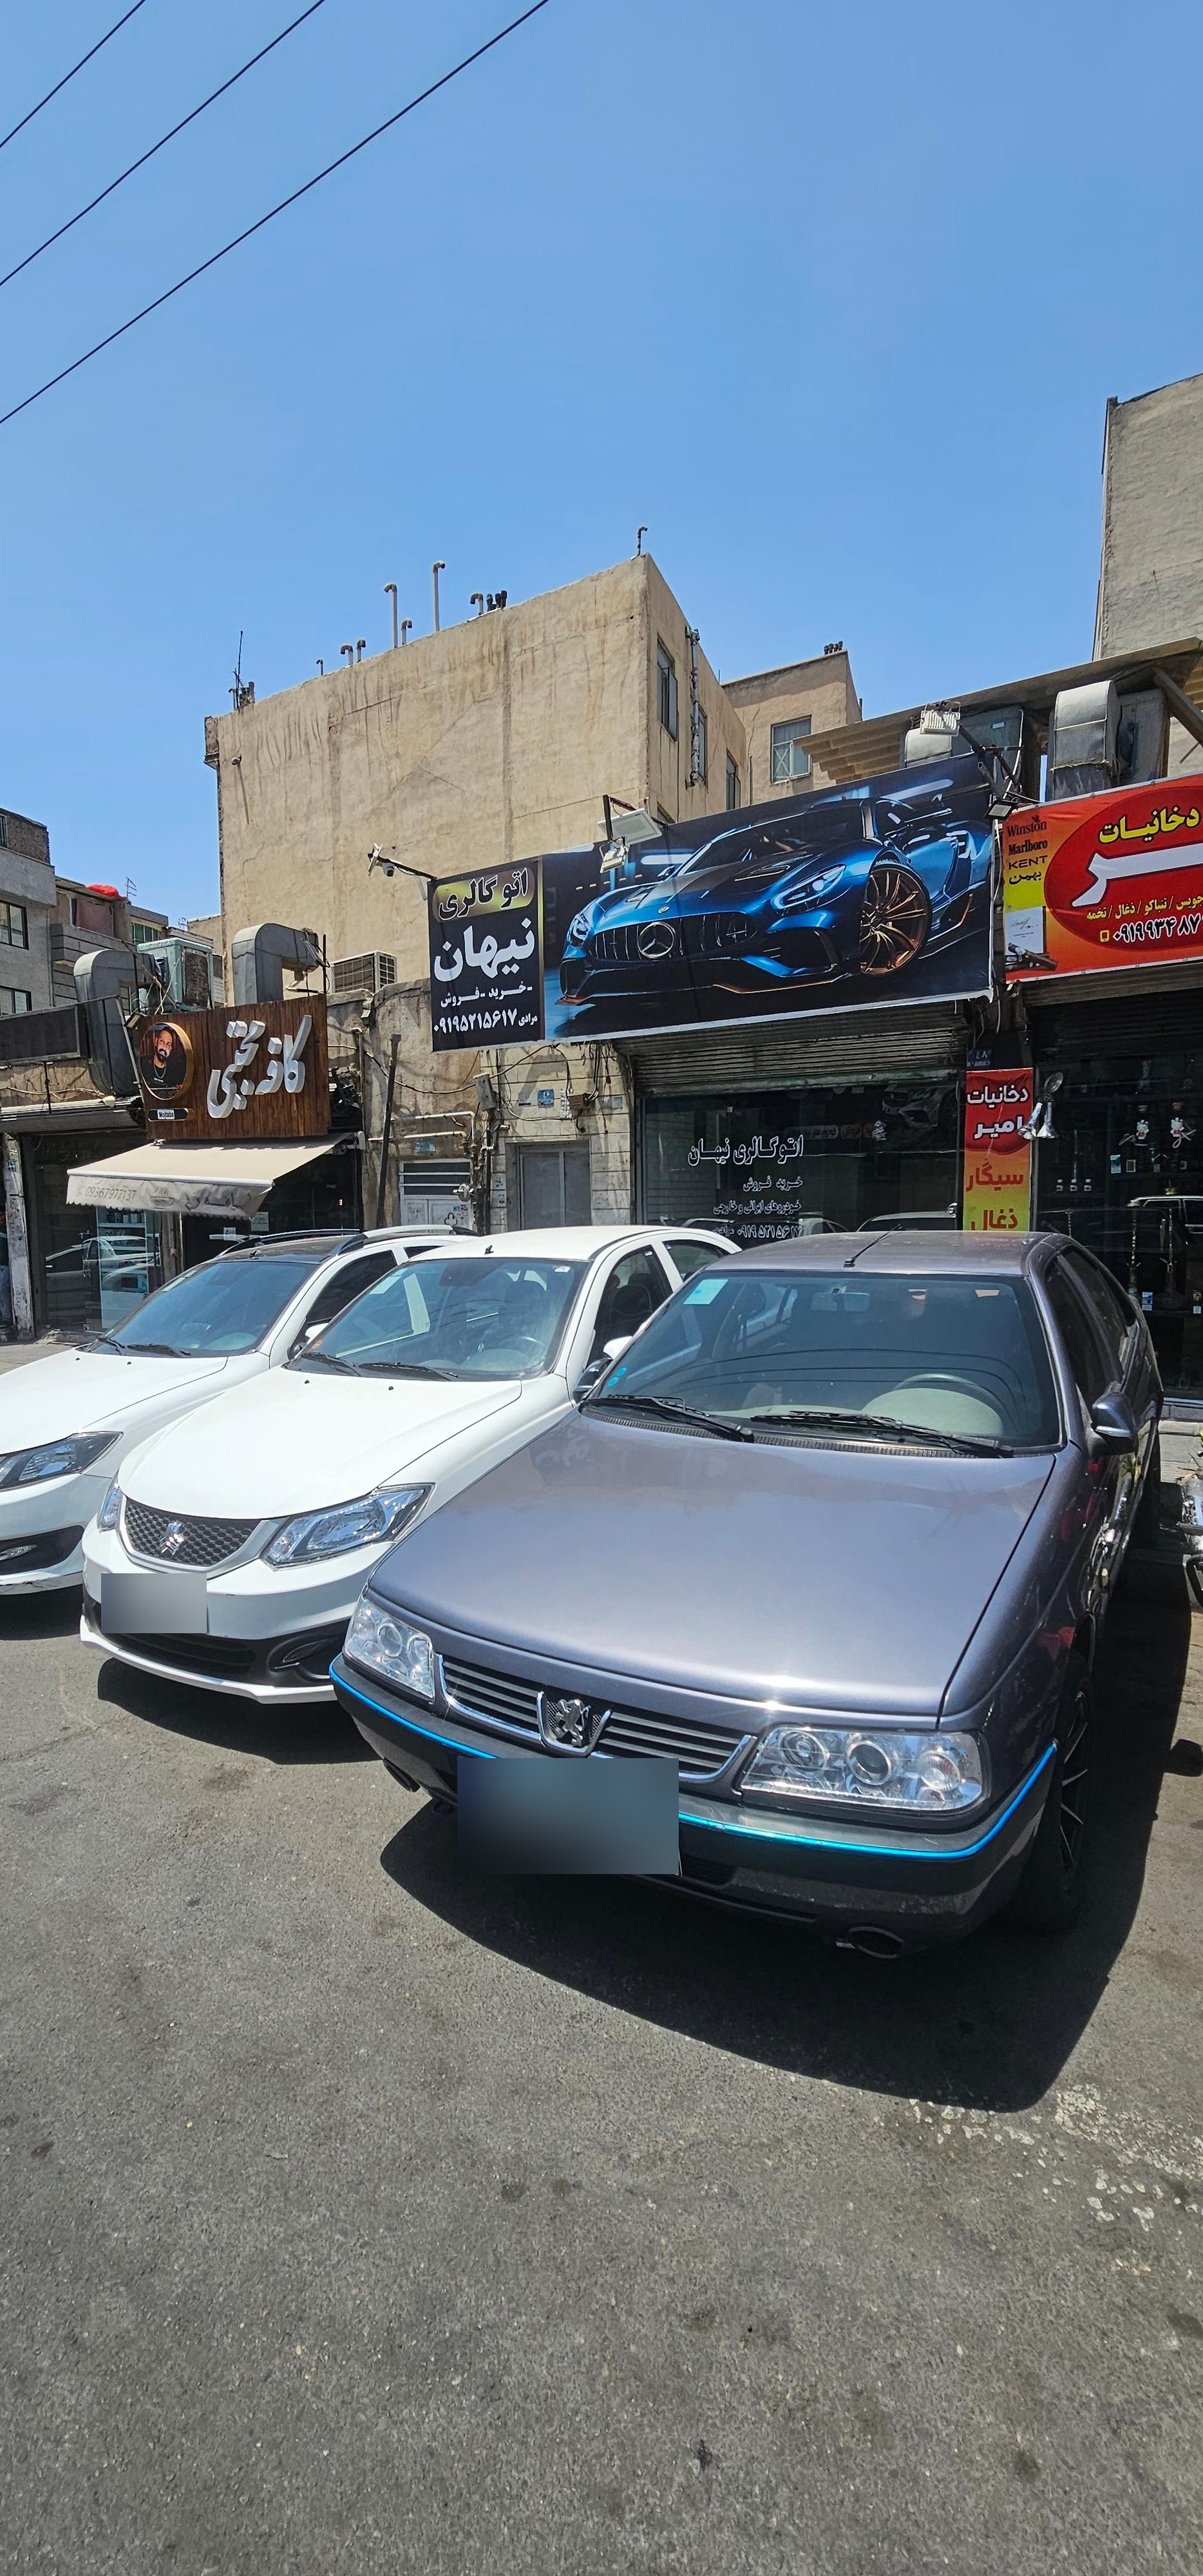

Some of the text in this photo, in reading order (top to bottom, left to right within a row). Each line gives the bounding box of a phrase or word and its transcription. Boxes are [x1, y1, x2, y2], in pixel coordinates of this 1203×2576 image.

[1007, 820, 1047, 837] Winston
[1098, 807, 1200, 843] دخانیات
[1009, 839, 1048, 855] Marlboro
[1009, 855, 1048, 869] KENT
[1009, 871, 1042, 885] بهمن
[439, 867, 528, 920] اتو گالری
[1086, 907, 1107, 920] تخمه
[1115, 902, 1135, 919] ذغال
[1144, 898, 1167, 915] تنباکو
[434, 917, 535, 982] نیهان
[433, 1008, 538, 1034] مرادی ۰۹۱۹۵۲۱۵۶۱۷
[207, 1014, 312, 1119] کافه مجتبی
[967, 1084, 1028, 1108] دخانیات
[974, 1116, 1023, 1139] امیر
[688, 1134, 804, 1166] اتو گالری نیهان
[743, 1175, 803, 1191] خرید فروش
[966, 1162, 1024, 1191] سیگار
